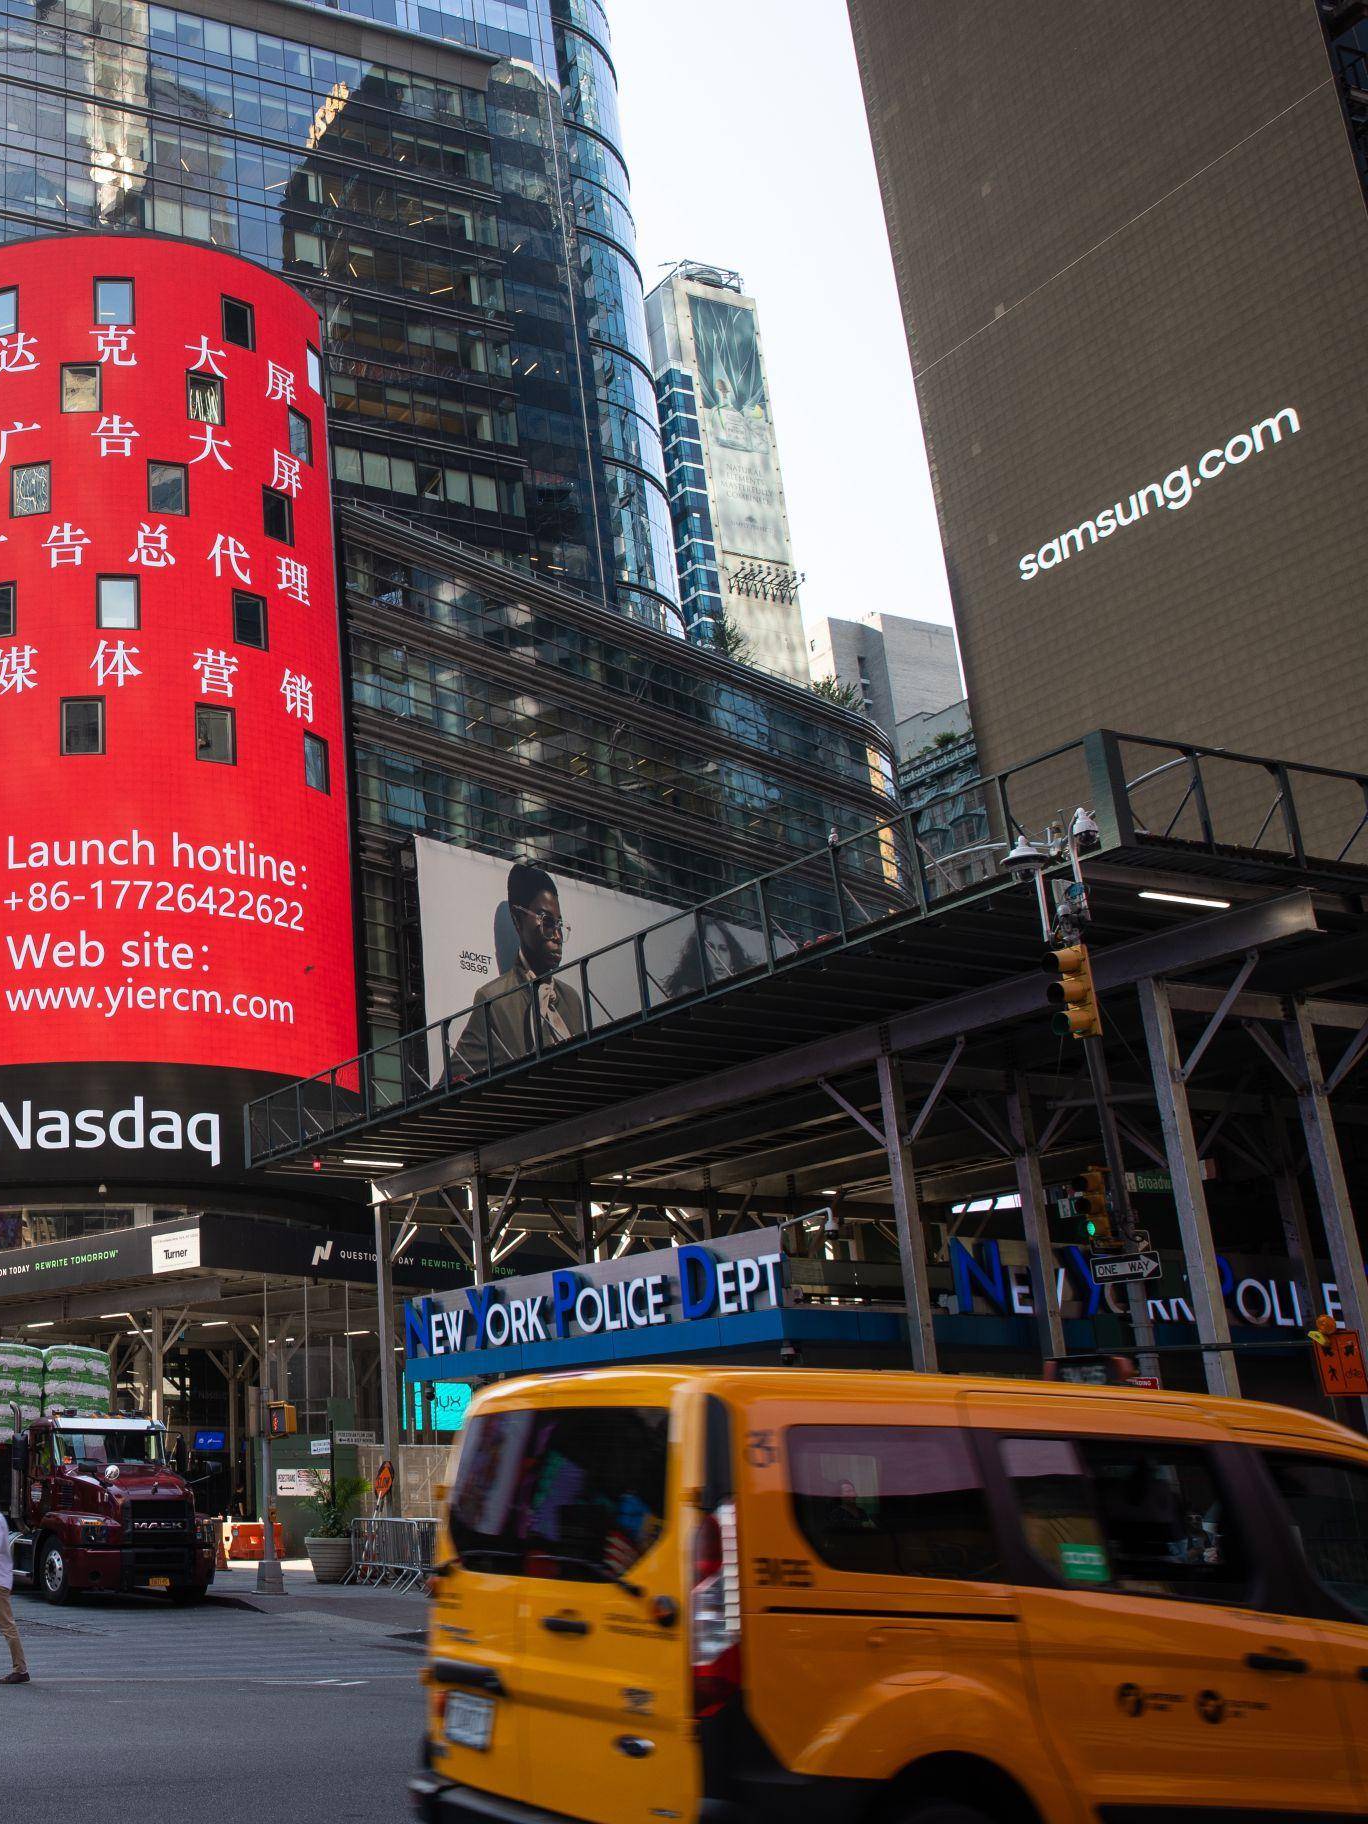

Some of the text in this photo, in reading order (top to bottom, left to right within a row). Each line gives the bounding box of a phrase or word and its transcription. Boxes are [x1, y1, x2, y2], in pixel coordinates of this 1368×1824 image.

[1018, 407, 1301, 581] samsung.com
[7, 830, 156, 870] Launch
[4, 879, 305, 932] +86-17726422622
[6, 930, 106, 971] Web
[459, 950, 493, 966] JACKET
[459, 960, 489, 975] $35.99
[6, 977, 294, 1025] www.yiercm.com
[9, 1265, 30, 1278] TODAY
[35, 1258, 68, 1271] REWRITE
[163, 1249, 188, 1260] Turner
[340, 1250, 378, 1262] QUESTIO
[421, 1259, 461, 1271] REWRITE
[1098, 1261, 1150, 1276] ONE WAY
[405, 1245, 782, 1358] NEW YORK POLICE DEPT
